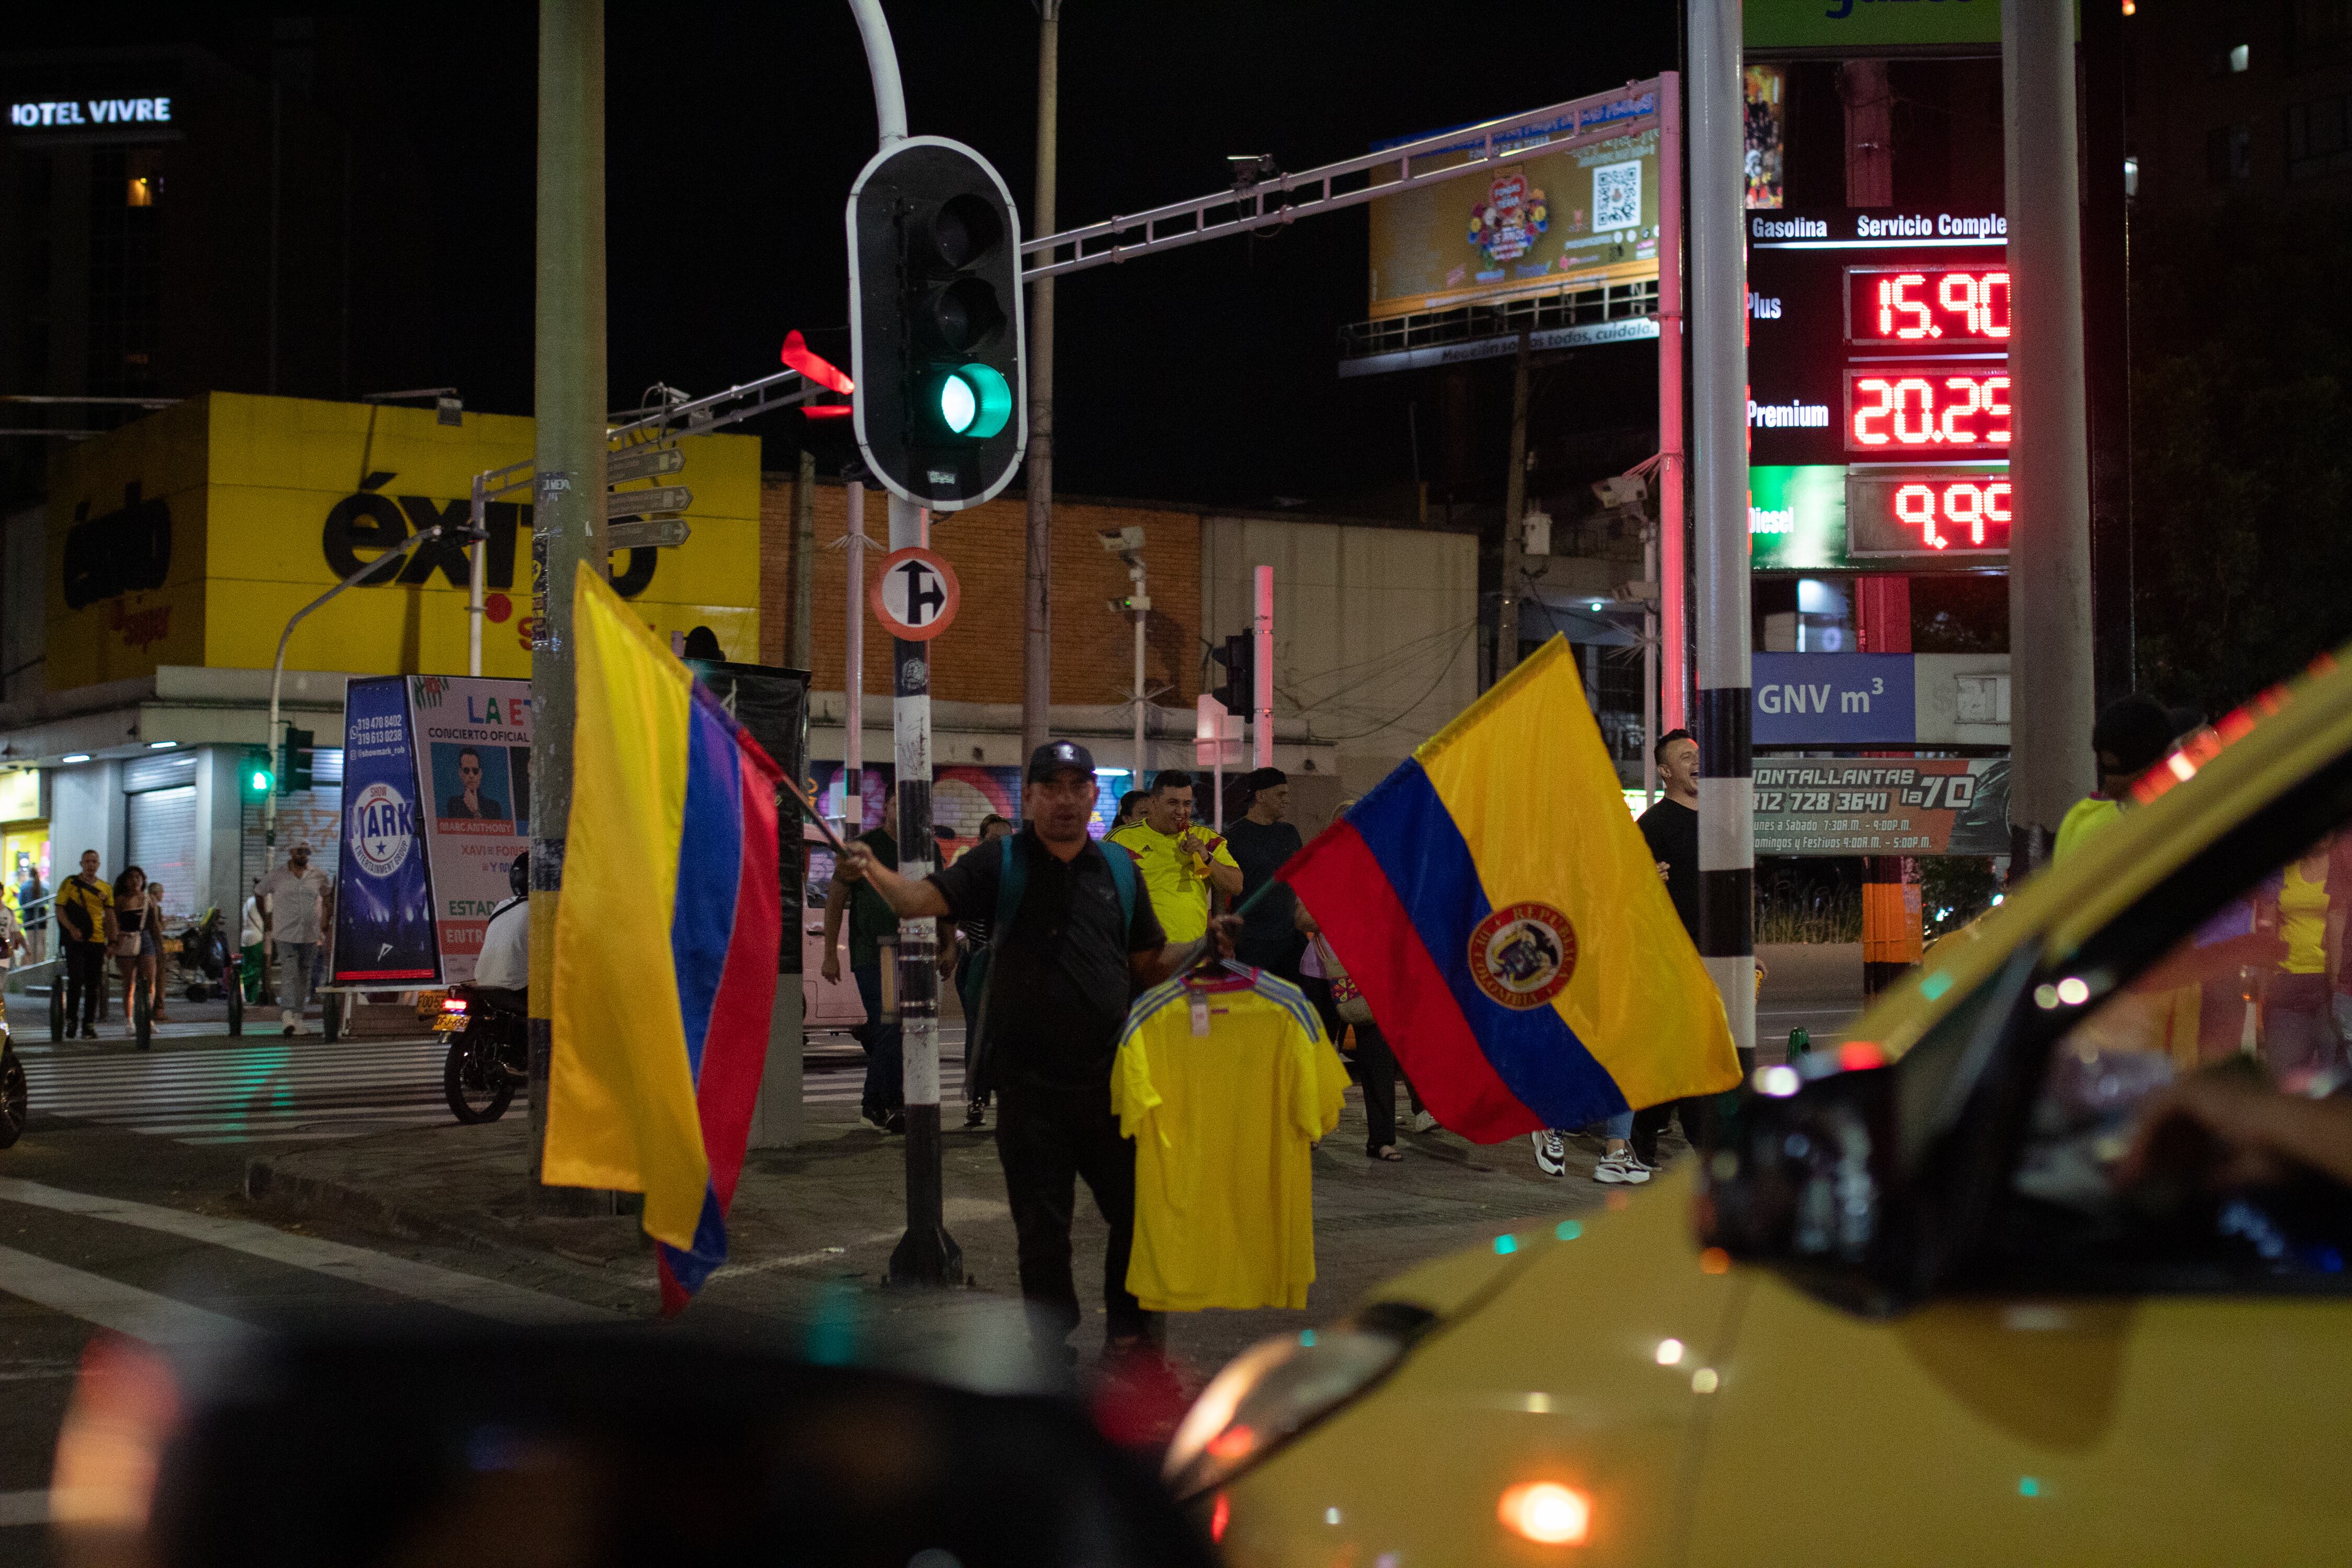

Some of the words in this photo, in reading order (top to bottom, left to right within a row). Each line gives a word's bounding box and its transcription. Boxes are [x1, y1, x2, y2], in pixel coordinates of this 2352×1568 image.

[88, 98, 171, 123] VIVRE
[1753, 217, 1827, 238] Gasolina
[1857, 214, 1932, 237] Servicio
[1938, 213, 2007, 238] Comple
[1748, 400, 1829, 428] Premium
[1748, 507, 1794, 534] Diesel
[1758, 684, 1831, 713] GNV
[468, 696, 502, 724] LA
[358, 718, 370, 731] 319
[358, 732, 370, 745] 319
[429, 728, 488, 740] CONCIERTO
[490, 731, 530, 743] OFICIAL
[370, 786, 387, 797] SHOW
[1921, 777, 1975, 808] 70
[1790, 792, 1831, 811] 728
[1836, 792, 1888, 811] 3641
[345, 803, 414, 839] MARK
[440, 822, 466, 833] MARC
[467, 823, 511, 834] ANTHONY
[1754, 820, 1775, 831] unes
[1778, 820, 1784, 831] a
[1786, 819, 1817, 831] Sabado
[461, 845, 486, 855] XAVI
[1755, 837, 1792, 851] omingos
[1795, 838, 1801, 850] y
[1803, 837, 1840, 848] Festivos
[355, 845, 395, 874] ENTERTAINMENT
[394, 840, 408, 863] GROUP
[449, 901, 496, 916] ESTAD
[446, 929, 483, 943] ENTR
